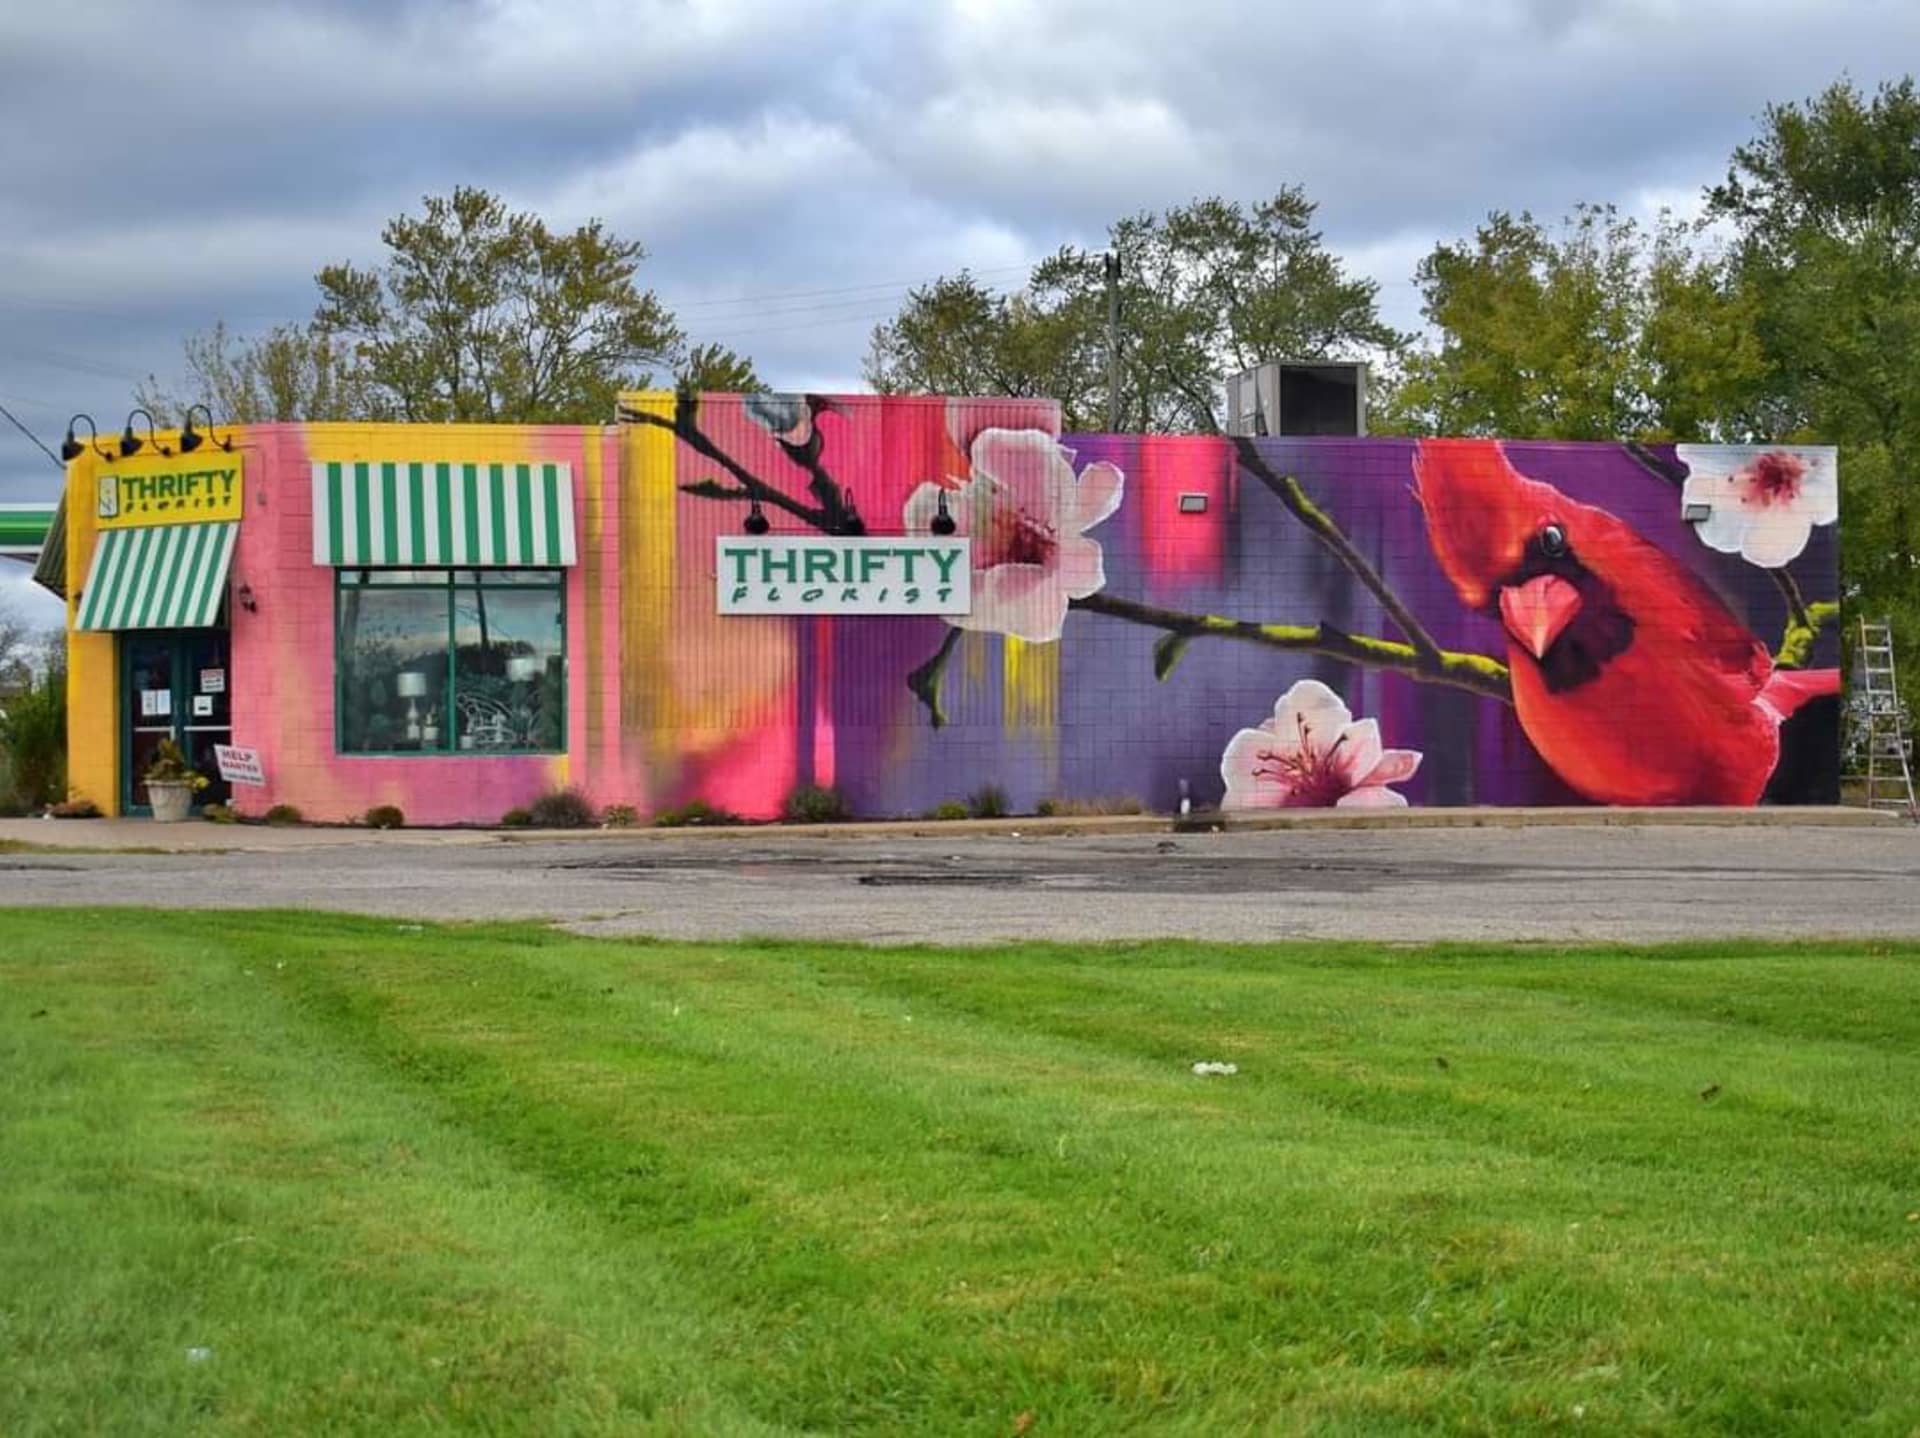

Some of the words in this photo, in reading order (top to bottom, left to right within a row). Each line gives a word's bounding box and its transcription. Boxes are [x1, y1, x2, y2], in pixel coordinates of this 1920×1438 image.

[122, 469, 237, 500] THRIFTY
[724, 548, 962, 583] THRIFTY
[731, 586, 953, 603] FLORIST
[222, 750, 252, 761] HELP
